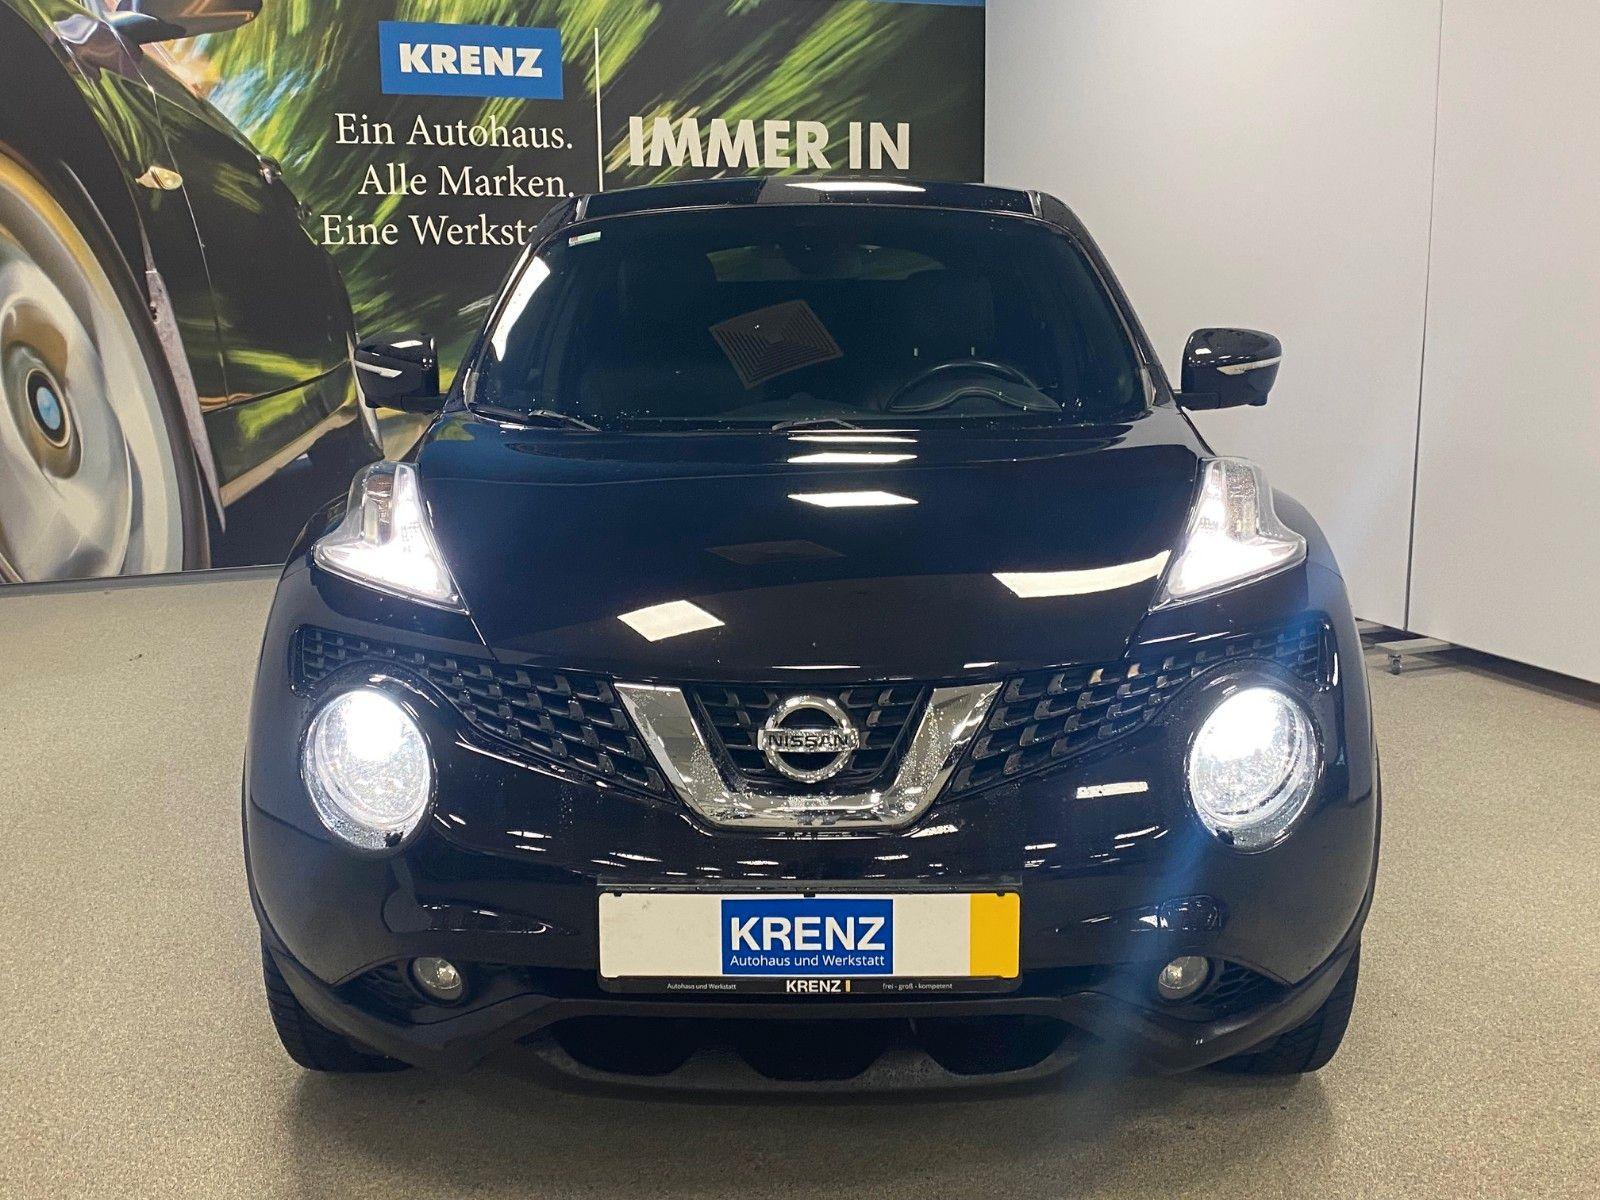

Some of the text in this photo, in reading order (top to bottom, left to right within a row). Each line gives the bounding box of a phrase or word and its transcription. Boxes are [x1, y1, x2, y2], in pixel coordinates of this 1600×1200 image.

[399, 43, 543, 78] KRENZ
[334, 112, 573, 149] Ein Autohaus.
[629, 116, 910, 170] IMMER IN
[357, 162, 574, 198] Alle Marken.
[320, 213, 537, 247] Eine Werkst
[768, 734, 848, 747] NISSAN
[731, 917, 885, 951] KRENZ
[730, 955, 885, 967] Autohaus und Werkstatt
[786, 980, 841, 992] KRENZ
